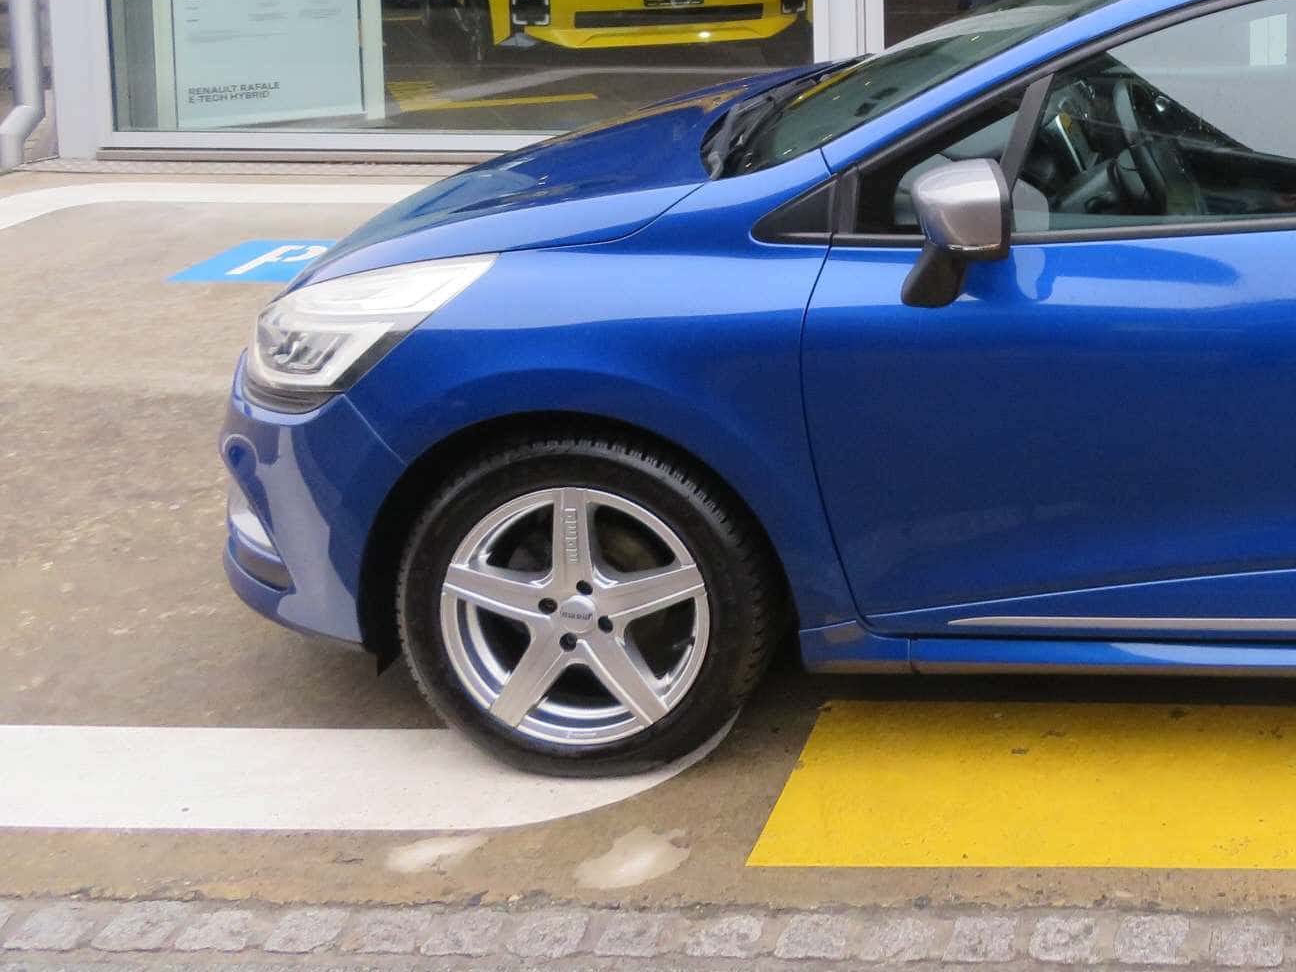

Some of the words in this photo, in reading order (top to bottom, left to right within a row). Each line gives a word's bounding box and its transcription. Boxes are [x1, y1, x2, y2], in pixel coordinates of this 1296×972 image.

[188, 84, 237, 95] RENAULT
[240, 81, 280, 92] RAFALE
[188, 94, 228, 104] E-TECH
[230, 90, 270, 101] HYBRID
